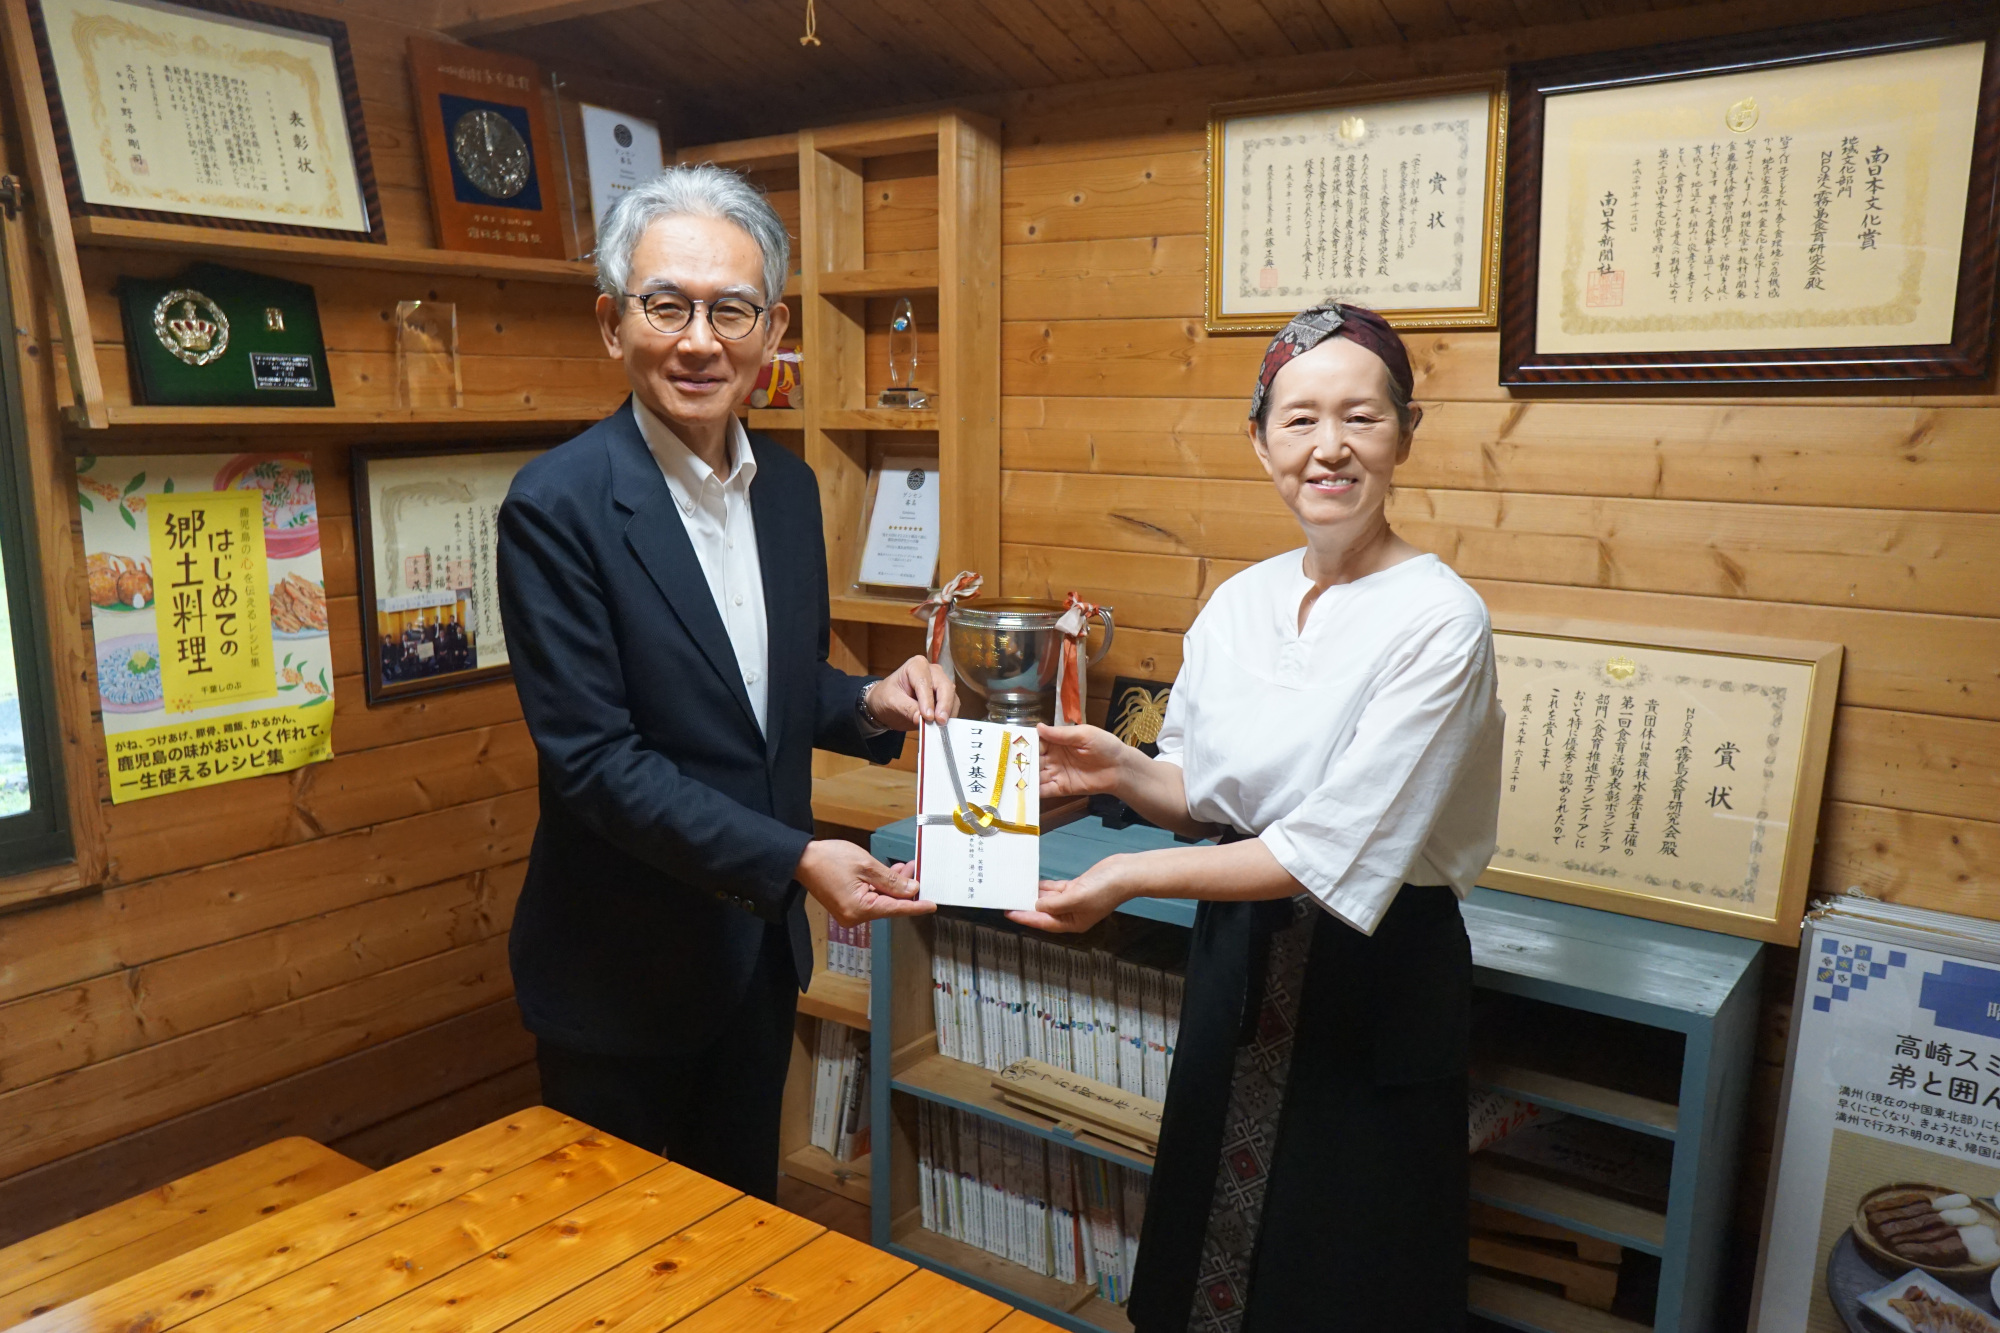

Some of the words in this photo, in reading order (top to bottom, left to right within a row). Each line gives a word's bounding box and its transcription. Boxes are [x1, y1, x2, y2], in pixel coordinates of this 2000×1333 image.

[289, 110, 315, 174] 表彰状
[1835, 136, 1859, 199] 地域文化部門
[1427, 171, 1448, 230] 賞状
[1597, 191, 1618, 276] 南日本新聞社
[1804, 151, 1833, 291] NPO法人霧島食育研究会殿
[1857, 145, 1889, 250] 南日本文化賞
[164, 509, 215, 676] 郷土料理
[208, 528, 240, 658] はじめての
[239, 506, 262, 669] 鹿児島の心を伝えるレシピ集
[201, 682, 242, 695] 千葉しのぶ
[1539, 688, 1560, 772] これを賞します
[114, 714, 298, 753] がね、つけあげ、豚骨、鶏飯、かるかん、
[117, 723, 325, 772] 鹿児島の味がおいしく作れて、
[119, 750, 285, 791] 一生使えるレシピ集
[967, 727, 986, 794] ココチ基金
[1509, 693, 1533, 793] 平成二十九年六月三十日
[1552, 690, 1586, 846] おいて特に優秀と認められたので
[1599, 695, 1635, 854] 第一回食育活動表彰ボランティア
[1704, 741, 1741, 811] 賞状
[1622, 698, 1660, 858] 貴団体は農林水産省主催の
[1656, 707, 1696, 858] NPO法人霧島食育研究会殿
